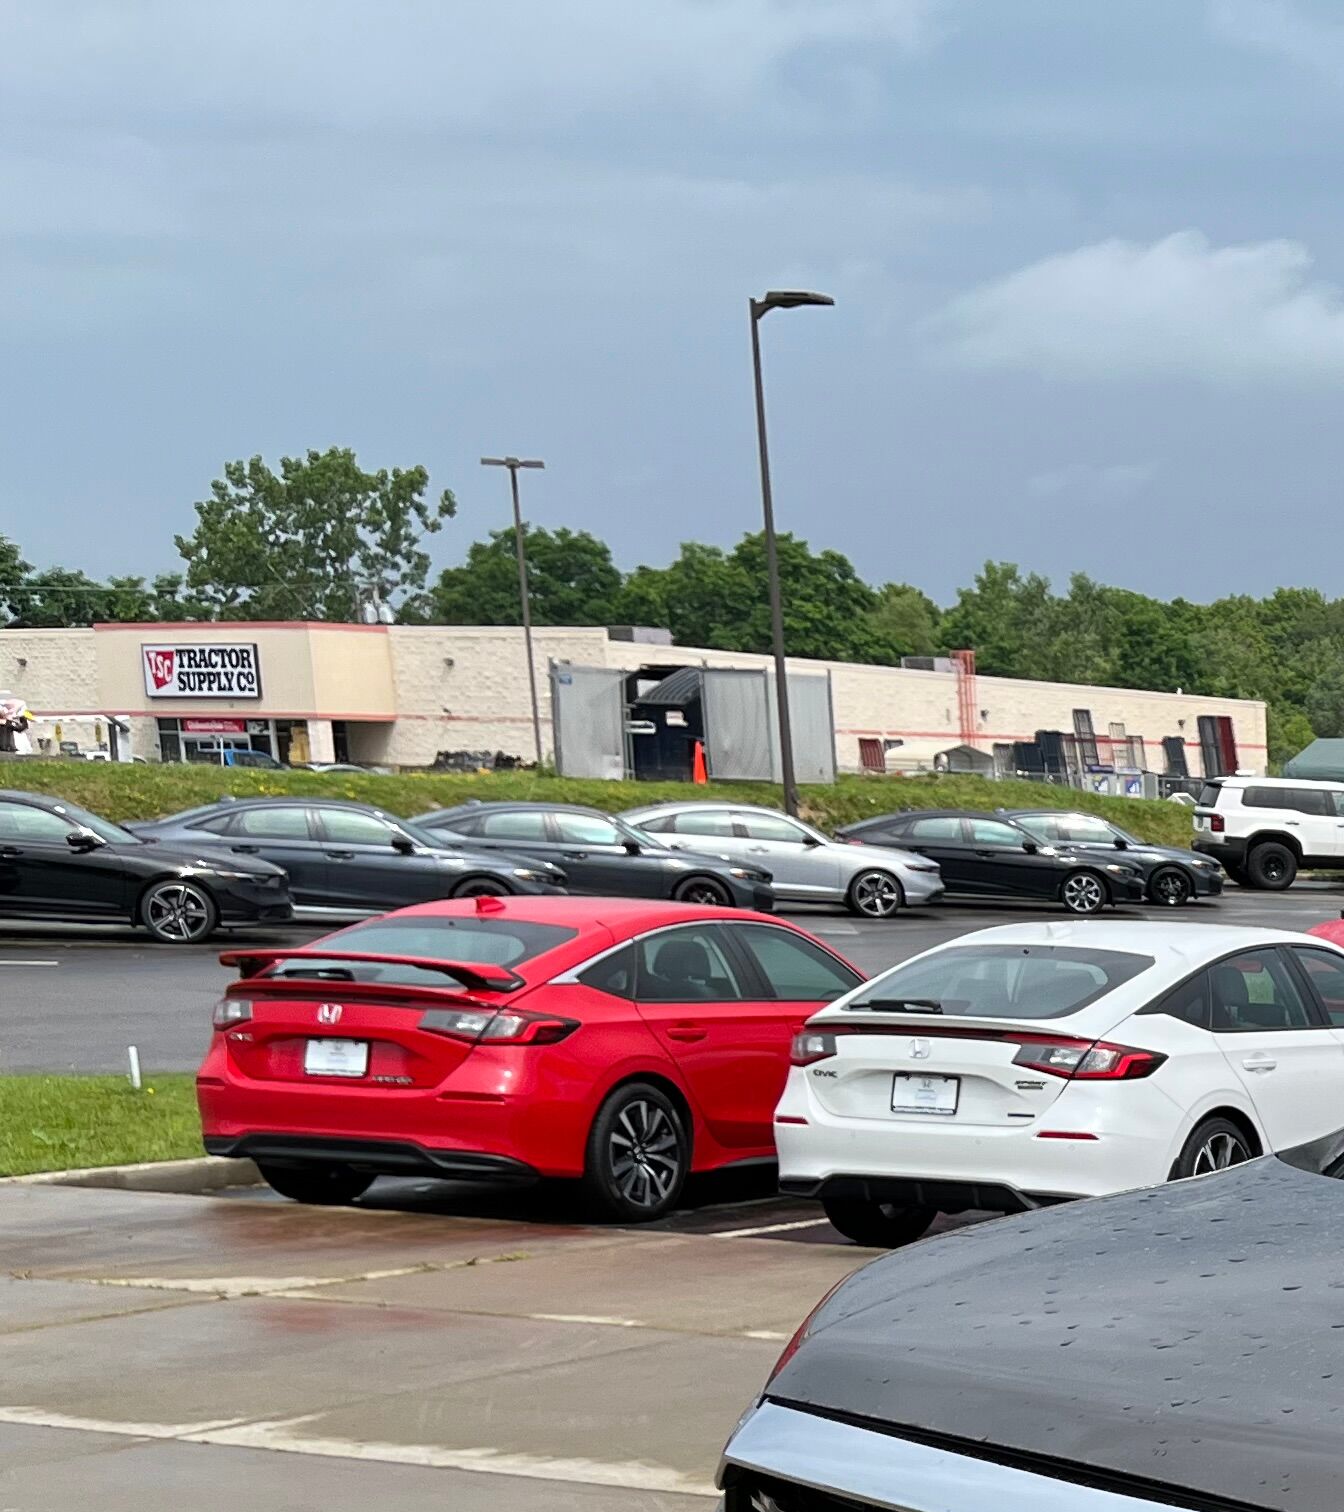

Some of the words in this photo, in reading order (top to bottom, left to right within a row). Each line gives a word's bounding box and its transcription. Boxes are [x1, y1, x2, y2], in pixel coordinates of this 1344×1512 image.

[147, 651, 172, 683] TSC
[175, 648, 253, 669] TRACTOR
[177, 671, 235, 692] SUPPLY
